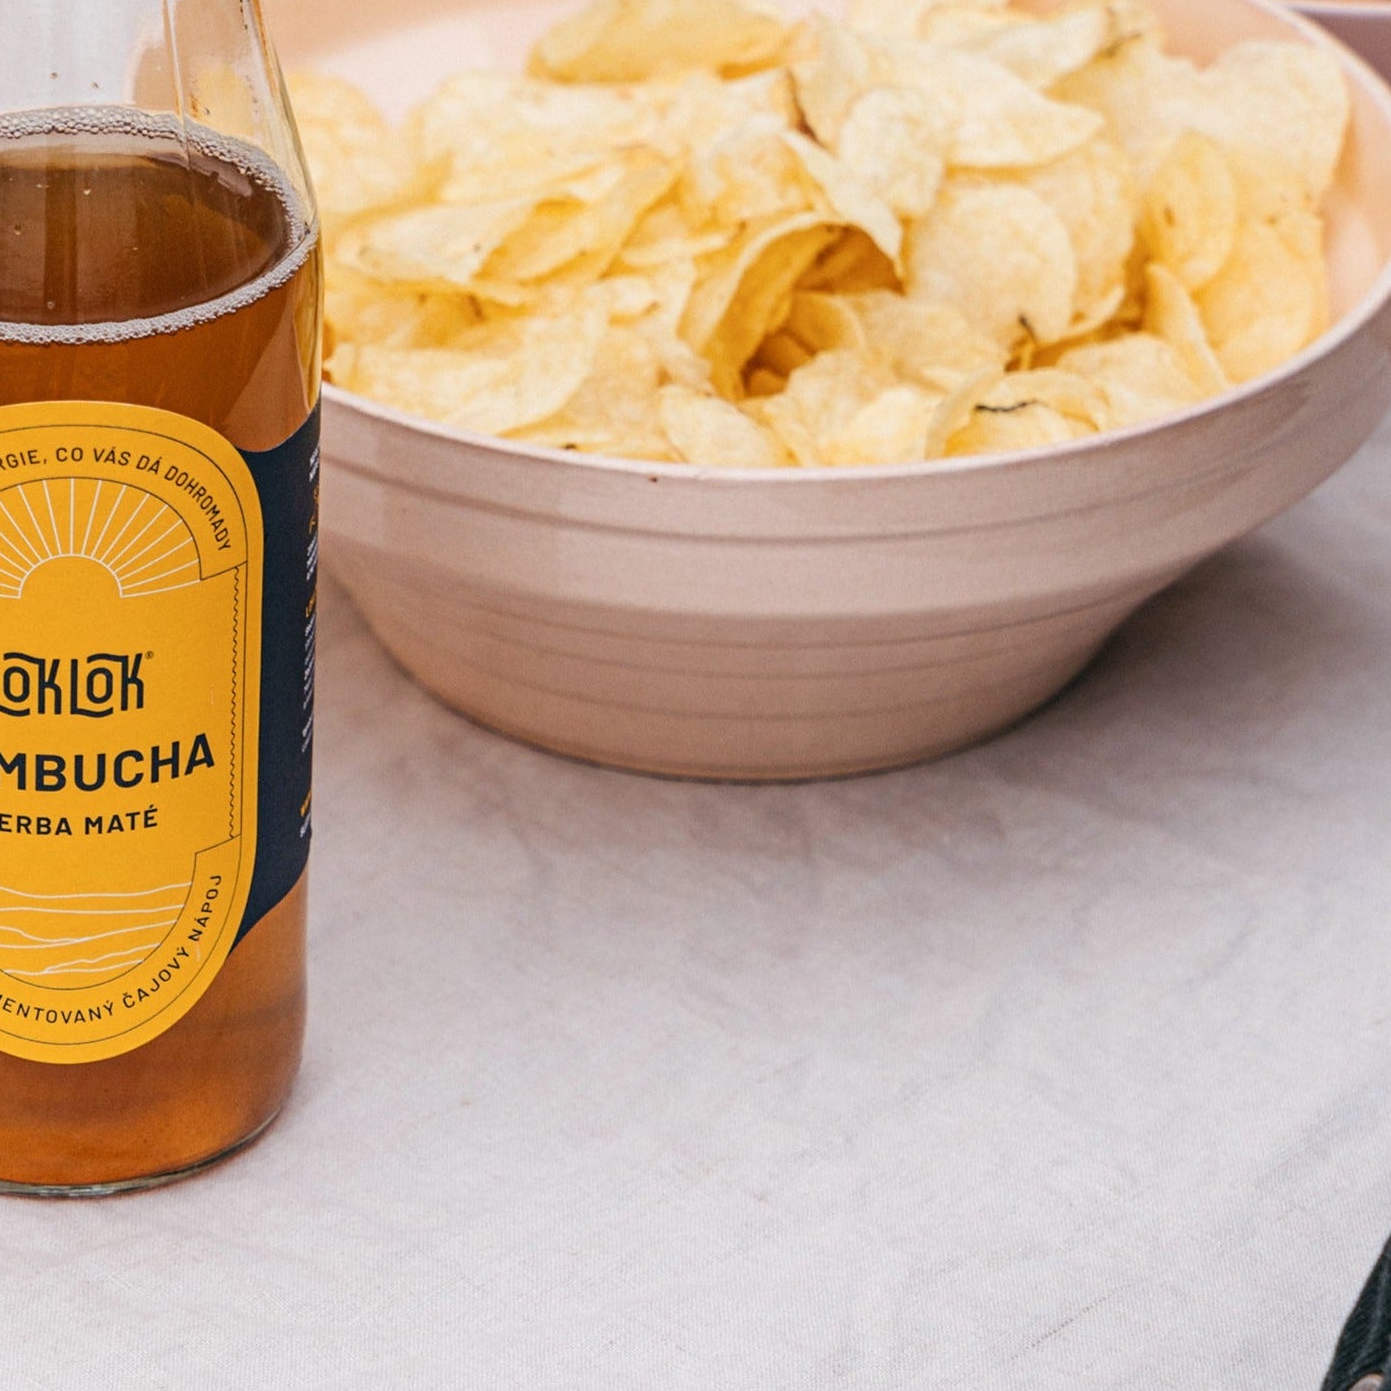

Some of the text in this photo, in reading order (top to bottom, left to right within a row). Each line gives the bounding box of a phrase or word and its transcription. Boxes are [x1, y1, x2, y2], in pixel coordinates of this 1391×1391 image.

[55, 447, 84, 462] CO
[93, 446, 131, 467] VÁS
[135, 456, 163, 476] DÁ
[163, 465, 232, 551] DOHROMADY
[84, 804, 159, 836] MATÉ
[122, 946, 190, 1009] ČAJOVÝ
[187, 875, 223, 942] NÁPOJ
